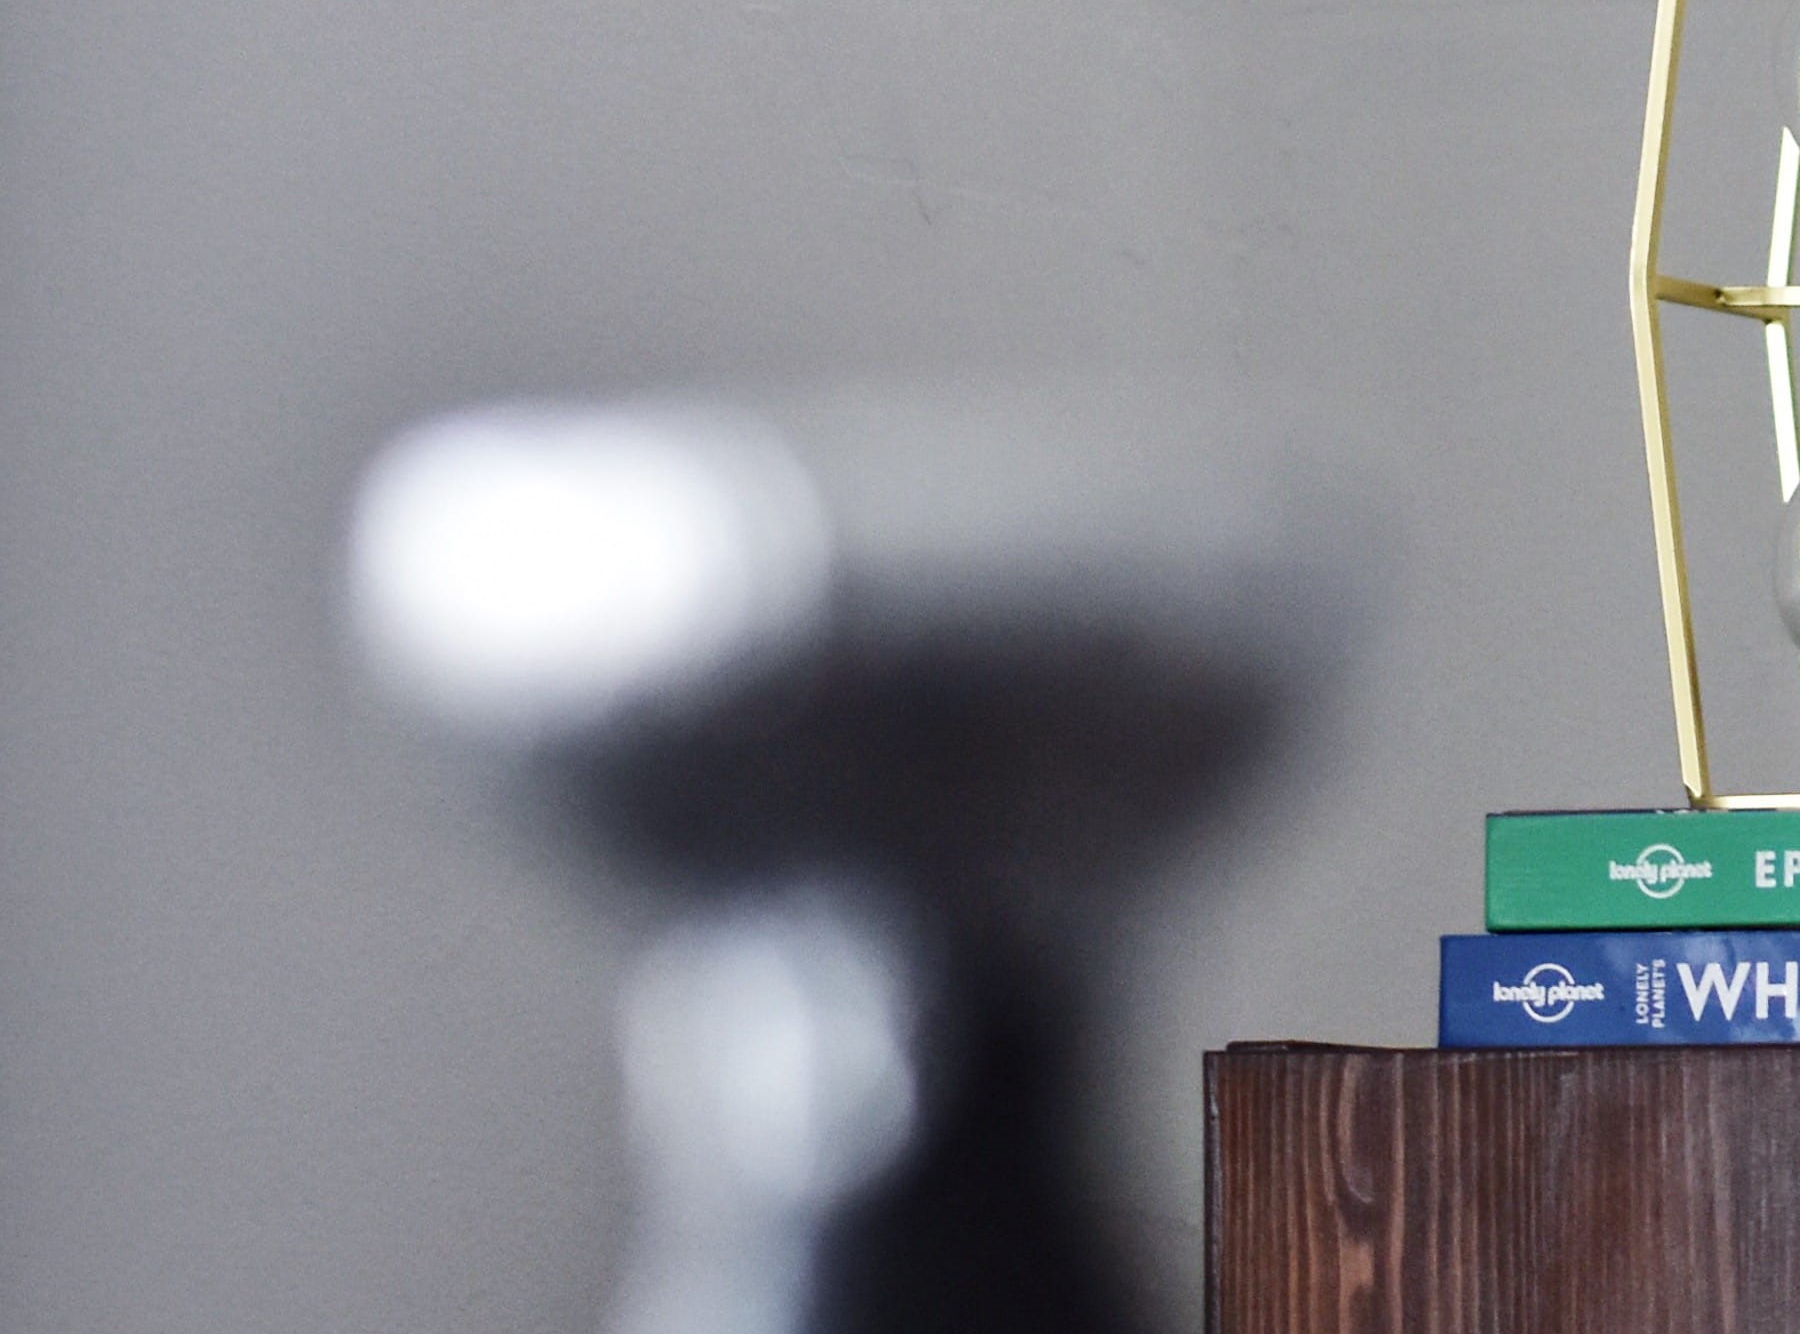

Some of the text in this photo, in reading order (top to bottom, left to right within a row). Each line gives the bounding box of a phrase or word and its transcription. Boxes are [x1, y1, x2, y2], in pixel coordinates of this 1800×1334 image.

[1609, 860, 1713, 885] lonely planet
[1493, 980, 1605, 1008] lonely planet
[1636, 962, 1650, 1025] LONELY
[1652, 958, 1666, 1029] PLANET'S
